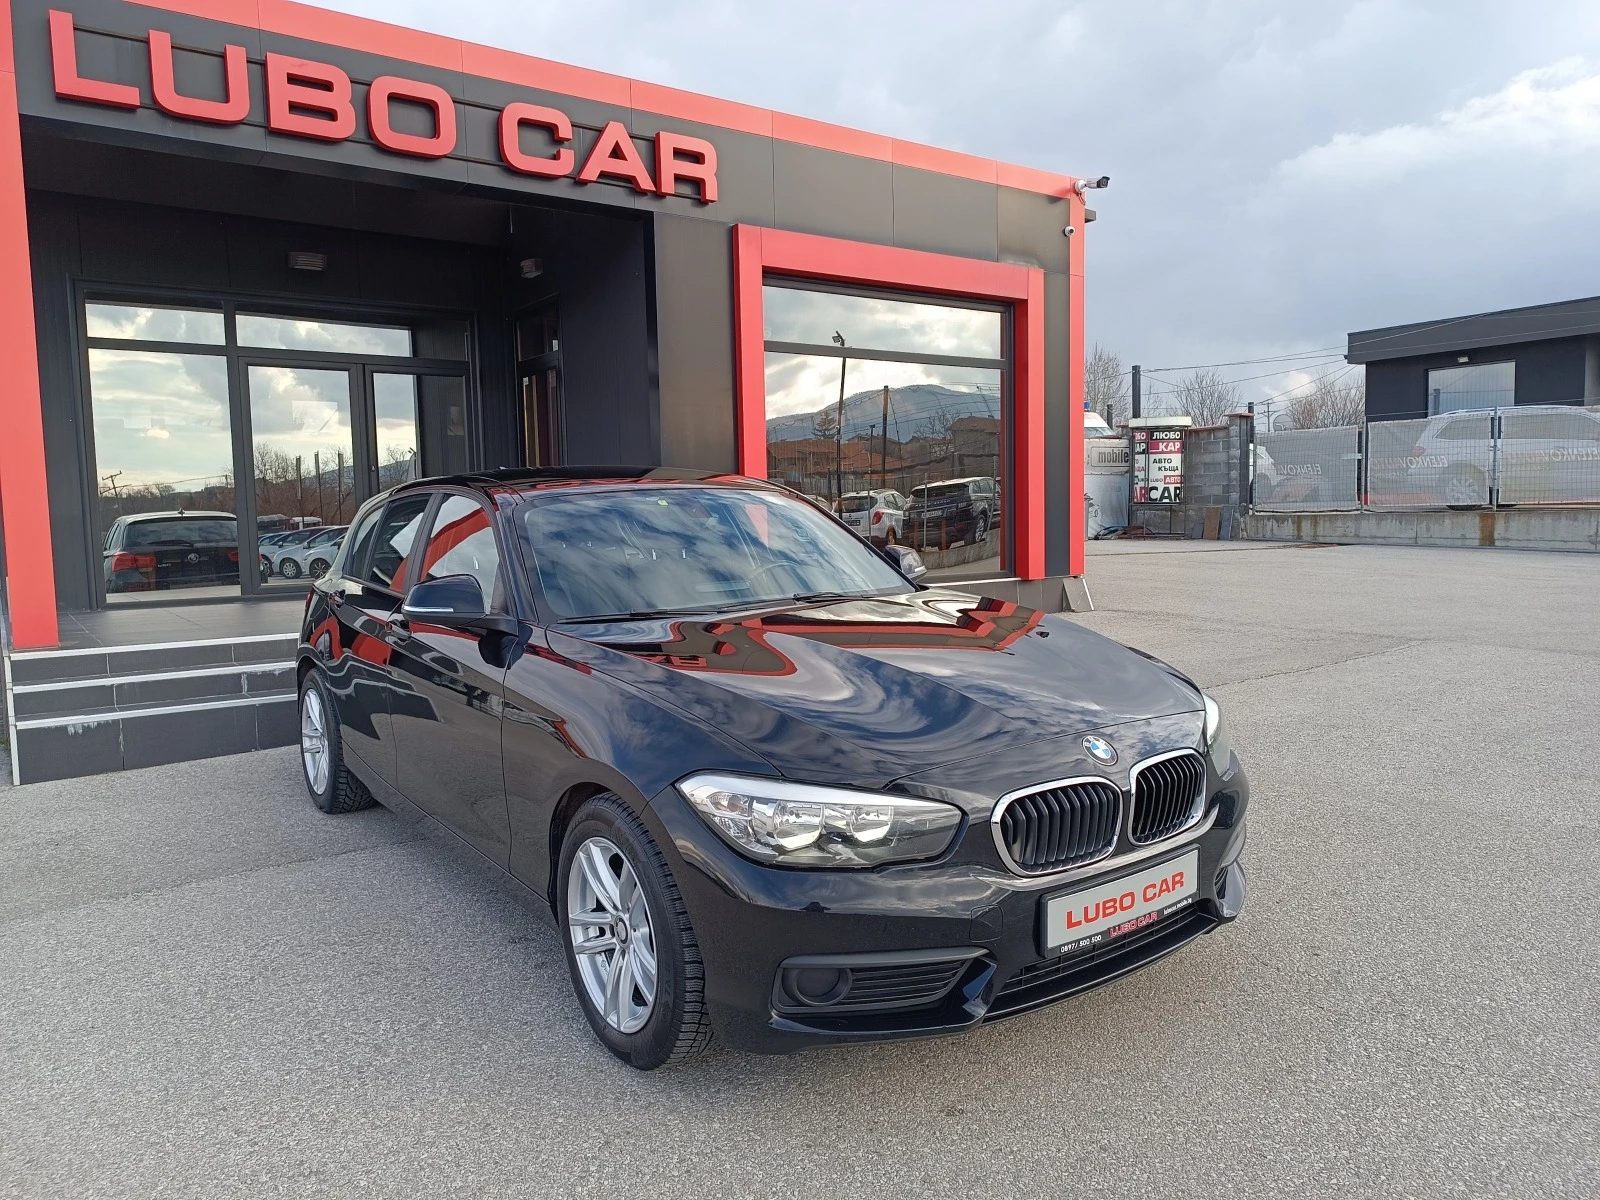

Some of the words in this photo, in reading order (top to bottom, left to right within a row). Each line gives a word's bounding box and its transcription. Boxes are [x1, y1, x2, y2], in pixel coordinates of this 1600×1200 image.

[49, 9, 457, 159] LUBO
[499, 101, 718, 204] CAR
[1152, 432, 1181, 440] ЛЮБО
[1158, 442, 1181, 452] КАР
[1149, 486, 1181, 501] CAR
[1066, 891, 1136, 930] LUBO
[1142, 871, 1185, 903] CAR
[1109, 919, 1137, 938] LUBO
[1137, 911, 1158, 927] CAR
